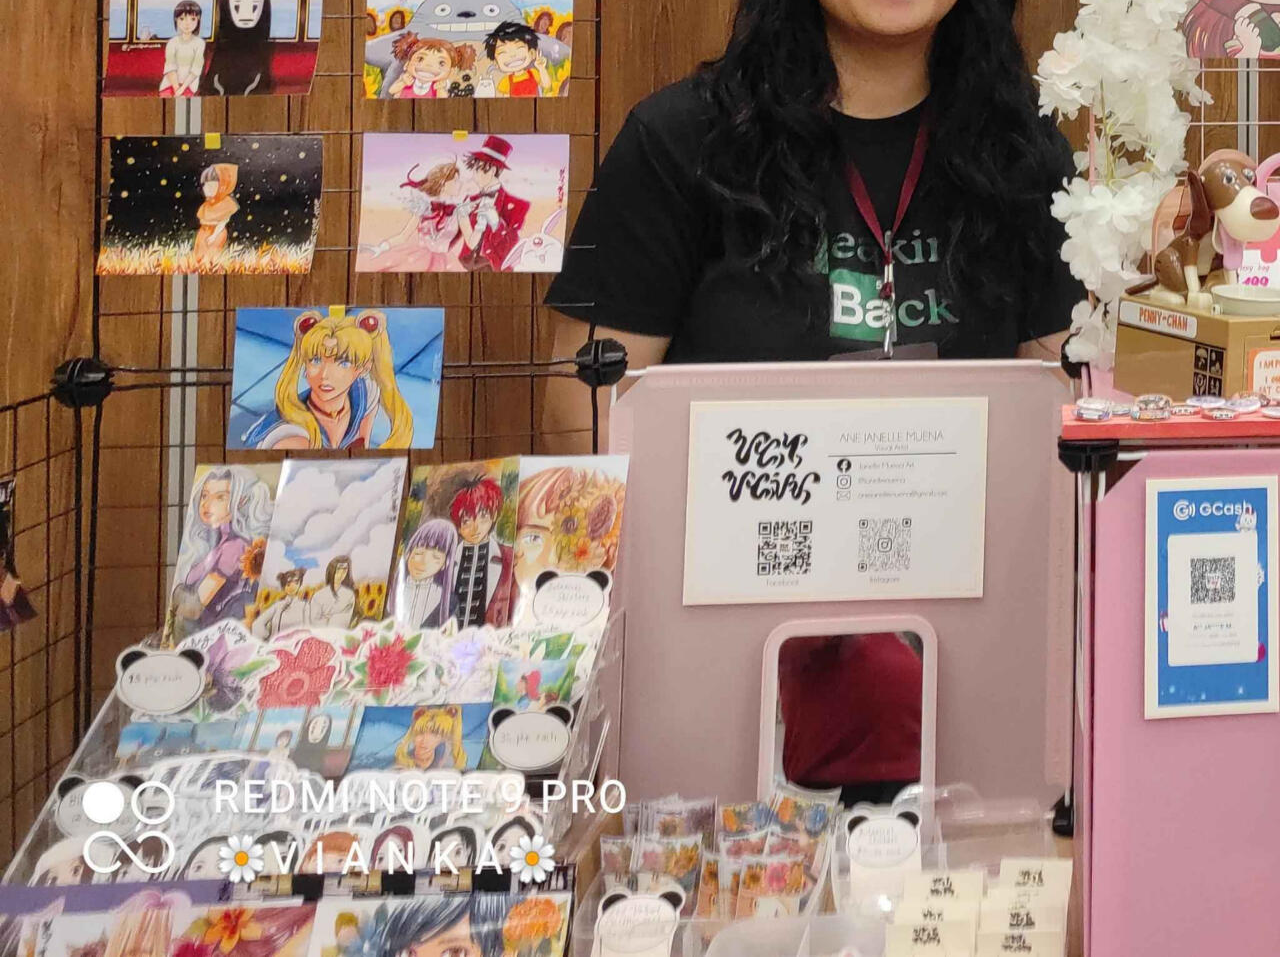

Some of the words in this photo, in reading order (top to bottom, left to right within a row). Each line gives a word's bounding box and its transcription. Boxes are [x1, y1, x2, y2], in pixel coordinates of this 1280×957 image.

[833, 283, 959, 328] Back
[1139, 307, 1188, 332] PENNY-CHAN
[1200, 500, 1252, 517] GCash
